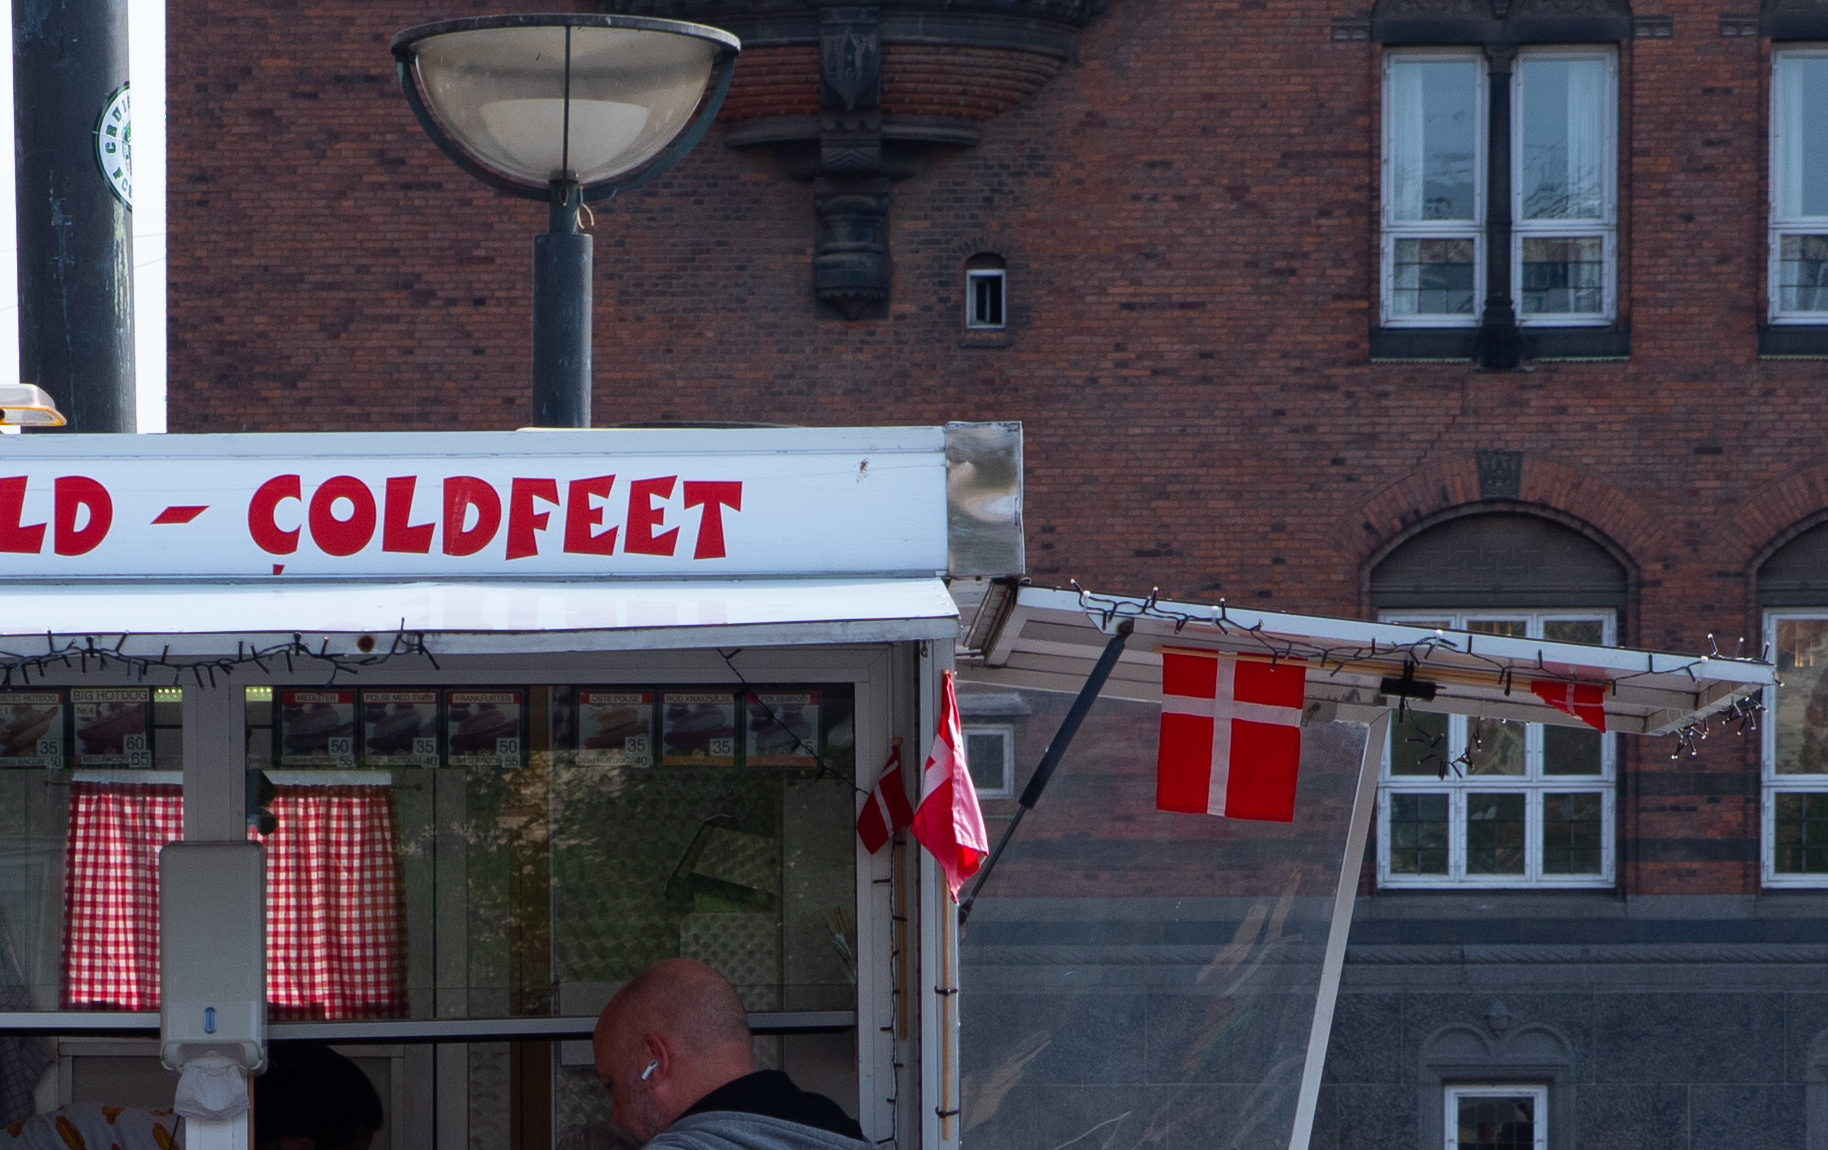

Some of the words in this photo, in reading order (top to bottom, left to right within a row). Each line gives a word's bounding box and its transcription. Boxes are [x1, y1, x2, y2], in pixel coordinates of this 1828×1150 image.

[248, 474, 743, 561] COLDFEET
[73, 690, 92, 700] BIG
[96, 690, 148, 700] HOTDOG
[76, 707, 95, 716] Nr.4
[39, 741, 58, 755] 35
[126, 736, 144, 750] 60
[330, 740, 349, 754] 50
[416, 740, 434, 754] 35
[499, 740, 518, 754] 50
[627, 738, 646, 752] 35
[713, 740, 731, 754] 35
[83, 754, 101, 762] MED
[131, 752, 149, 766] 65
[339, 756, 353, 766] 55
[424, 756, 438, 766] 40
[634, 756, 648, 766] 40
